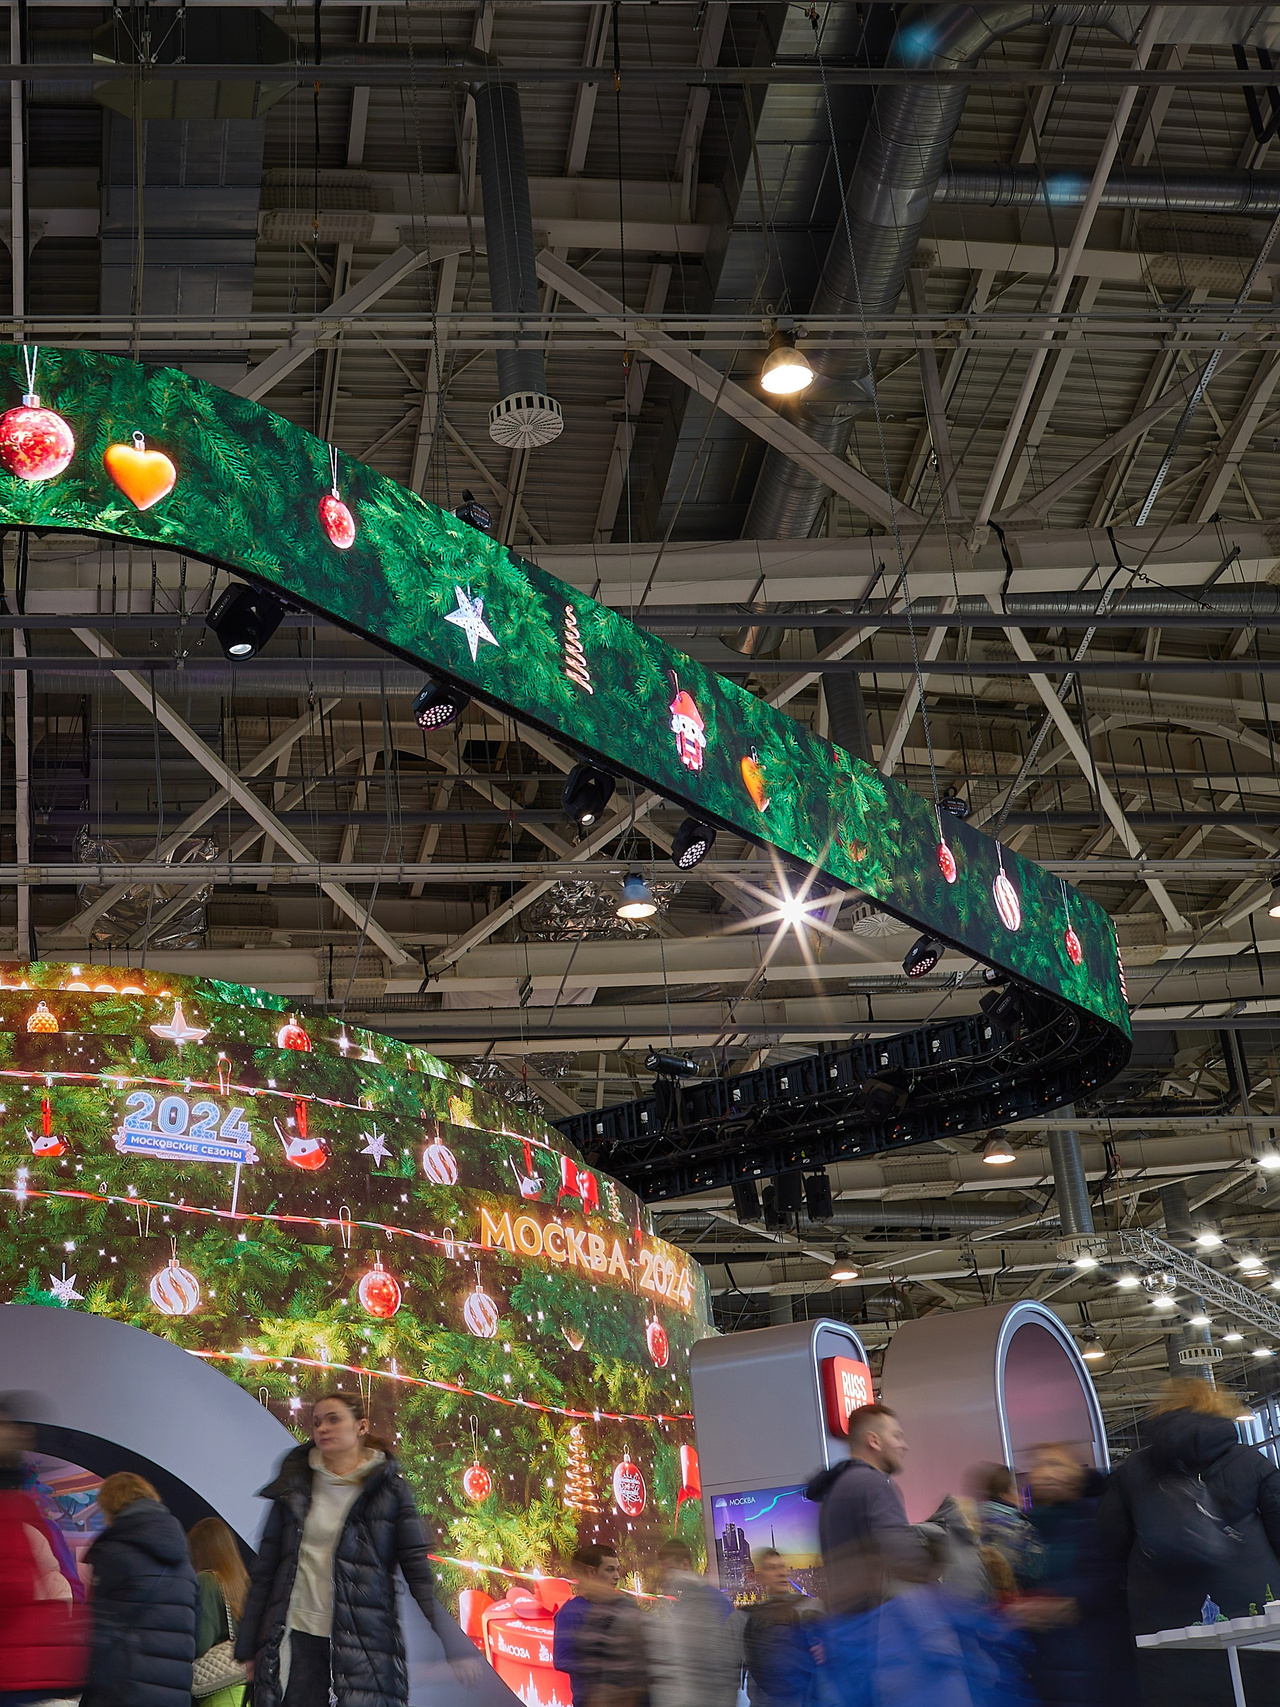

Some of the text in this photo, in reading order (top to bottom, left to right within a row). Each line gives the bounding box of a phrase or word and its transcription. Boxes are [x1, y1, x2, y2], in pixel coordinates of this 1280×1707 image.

[123, 1091, 252, 1145] 2024
[130, 1135, 243, 1160] МОСКОВСКИЕ СЕЗОНЫ
[480, 1208, 693, 1307] МОСКВА 2024
[841, 1370, 867, 1401] RUSS
[844, 1397, 868, 1419] PA
[729, 1496, 756, 1507] МОСКВА
